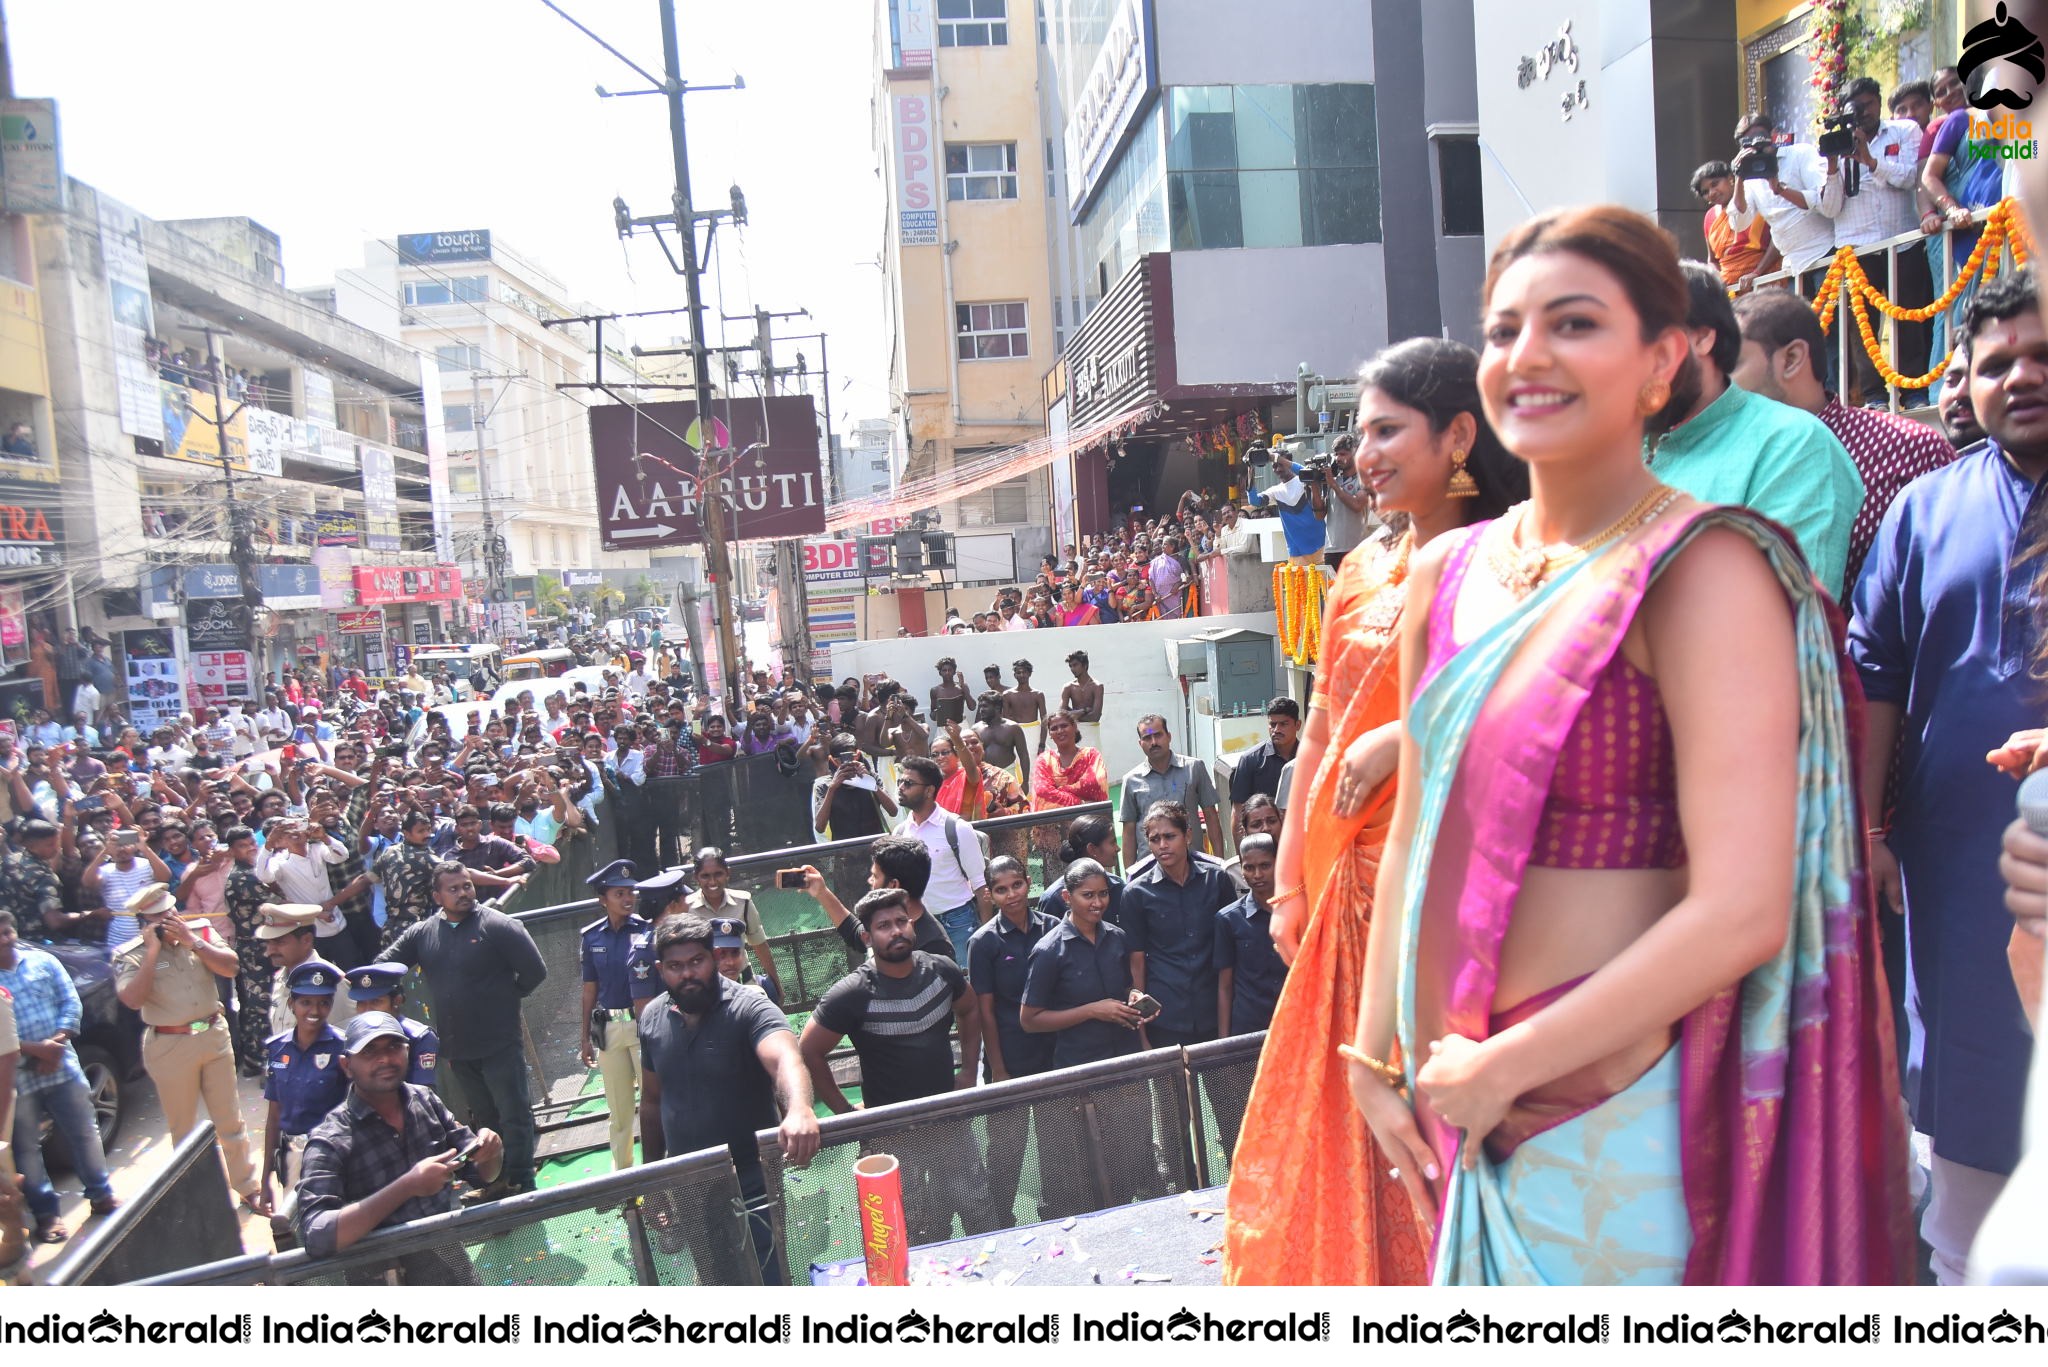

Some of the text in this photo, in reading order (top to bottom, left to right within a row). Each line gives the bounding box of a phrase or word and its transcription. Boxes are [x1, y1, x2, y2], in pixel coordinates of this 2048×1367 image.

[900, 98, 930, 209] BDPS
[902, 212, 936, 220] COMPUTER
[903, 220, 937, 228] EDUCATION
[437, 231, 481, 247] touch
[609, 472, 817, 521] AAKRUTI
[864, 1192, 894, 1260] Angel's
